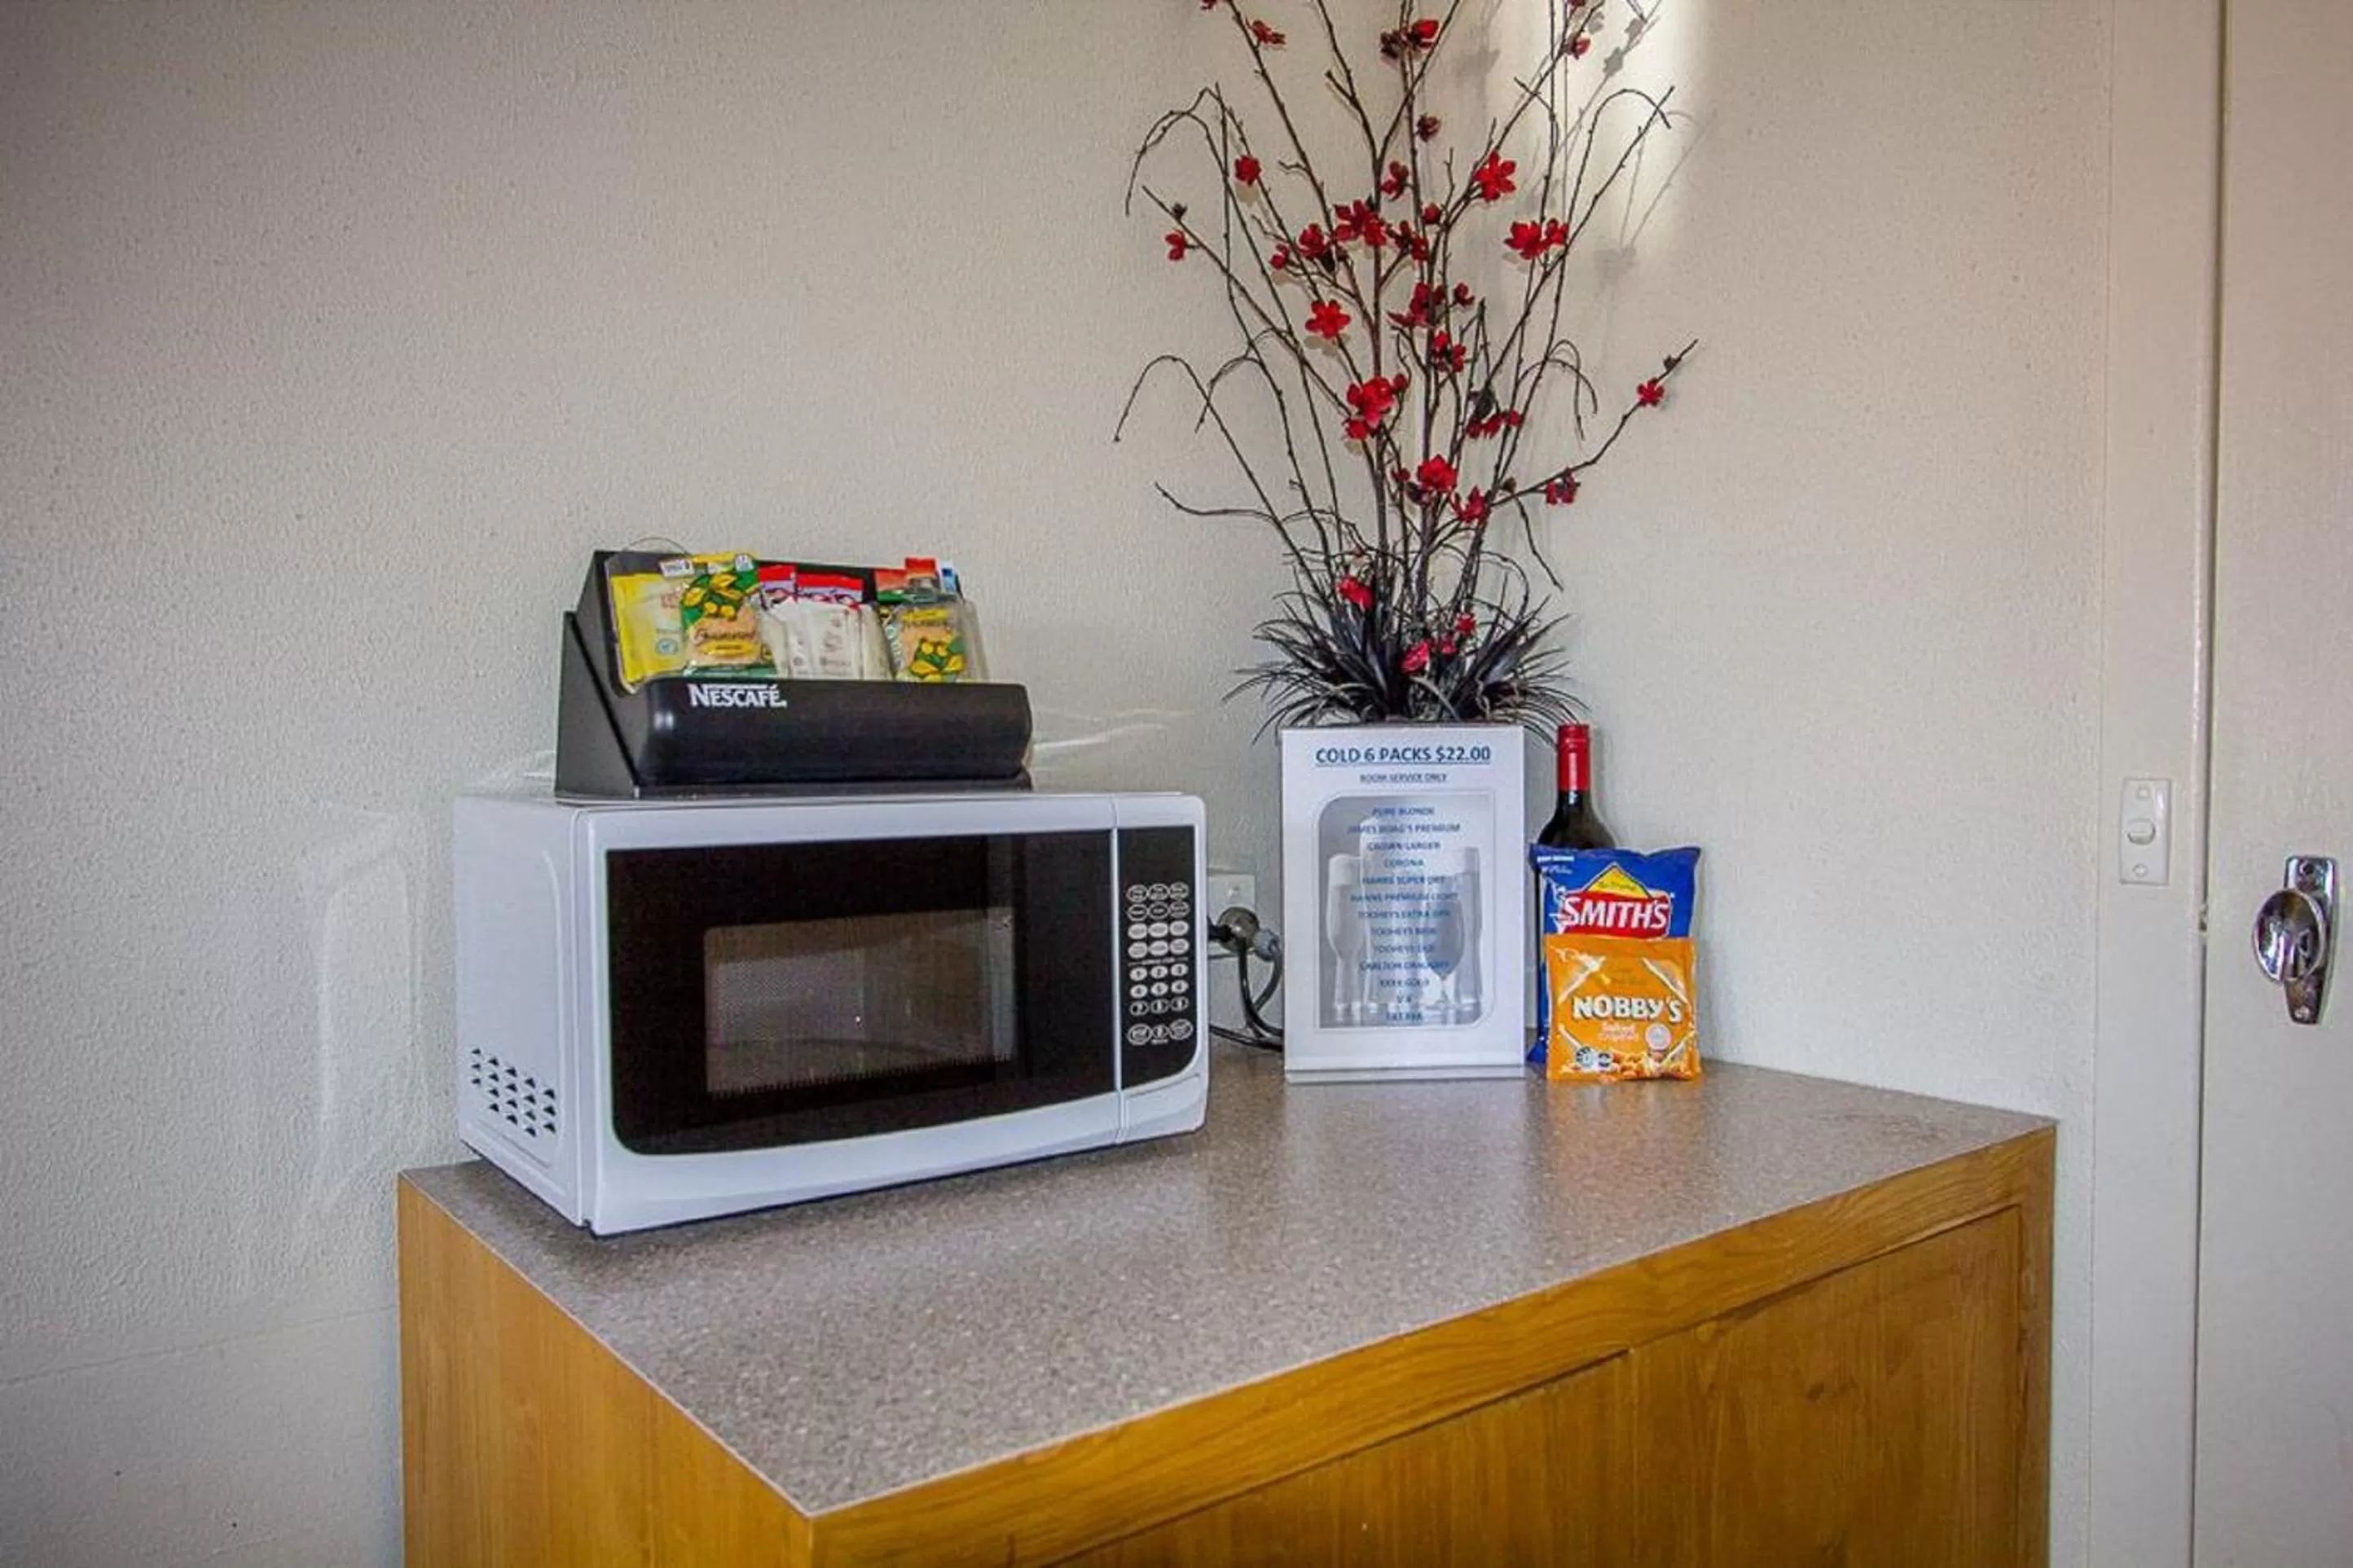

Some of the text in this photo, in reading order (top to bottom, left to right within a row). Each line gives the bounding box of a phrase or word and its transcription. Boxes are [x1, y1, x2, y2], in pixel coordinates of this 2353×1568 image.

[1315, 744, 1491, 763] COLD 6 PACKS $22.00
[1389, 773, 1423, 783] SERVICE
[1425, 773, 1447, 782] ONLY
[1415, 823, 1461, 832] PREMIUM
[1384, 859, 1424, 868] CORONA
[1559, 895, 1669, 930] SMITH'S
[1572, 993, 1683, 1024] NOBBY'S
